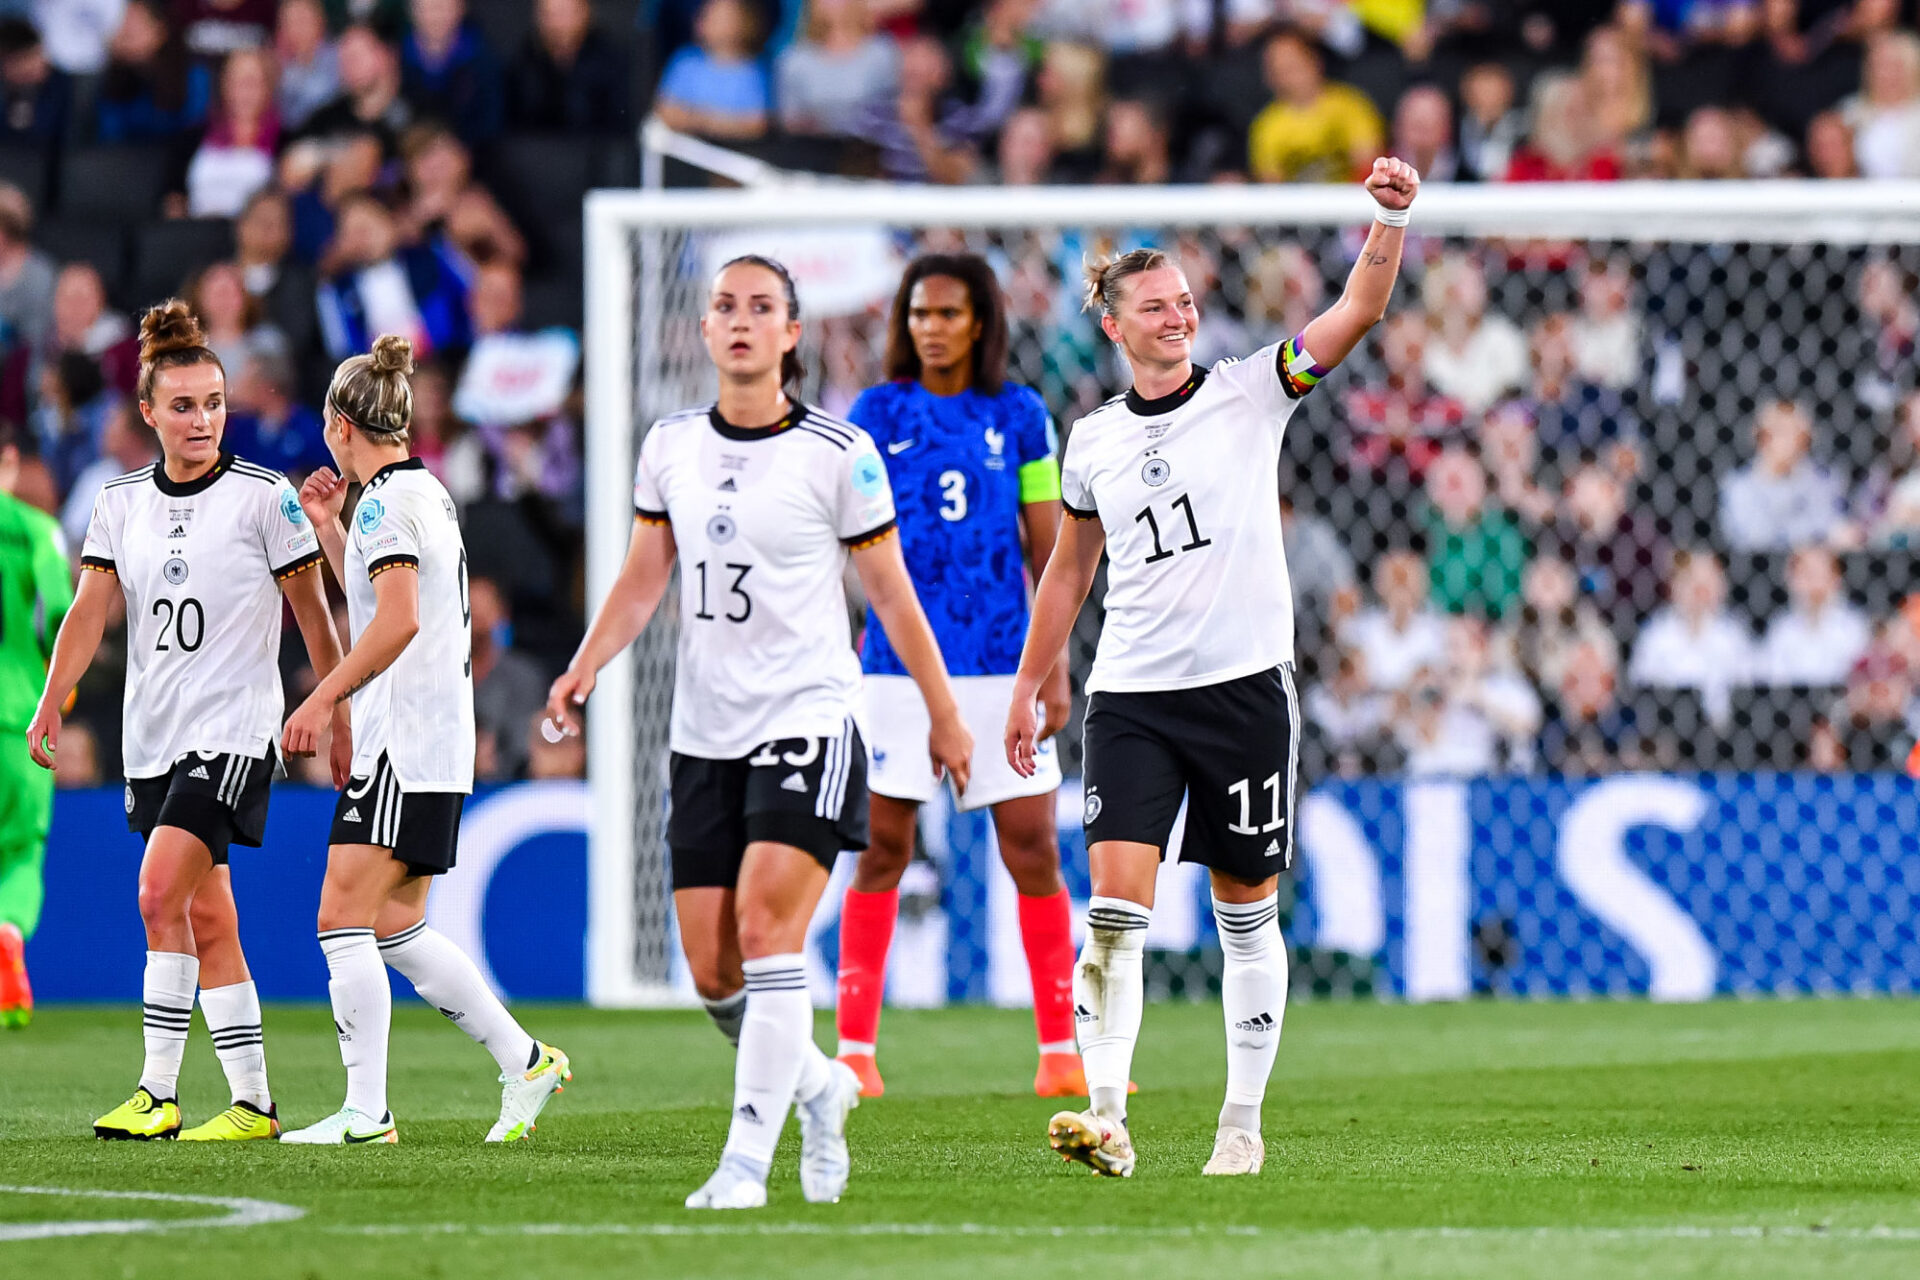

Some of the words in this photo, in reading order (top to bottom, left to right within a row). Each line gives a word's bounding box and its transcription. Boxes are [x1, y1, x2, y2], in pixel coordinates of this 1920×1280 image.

[938, 469, 968, 522] 3
[1134, 492, 1212, 565] 11
[695, 560, 753, 624] 13
[152, 597, 205, 653] 20
[1228, 771, 1285, 836] 11
